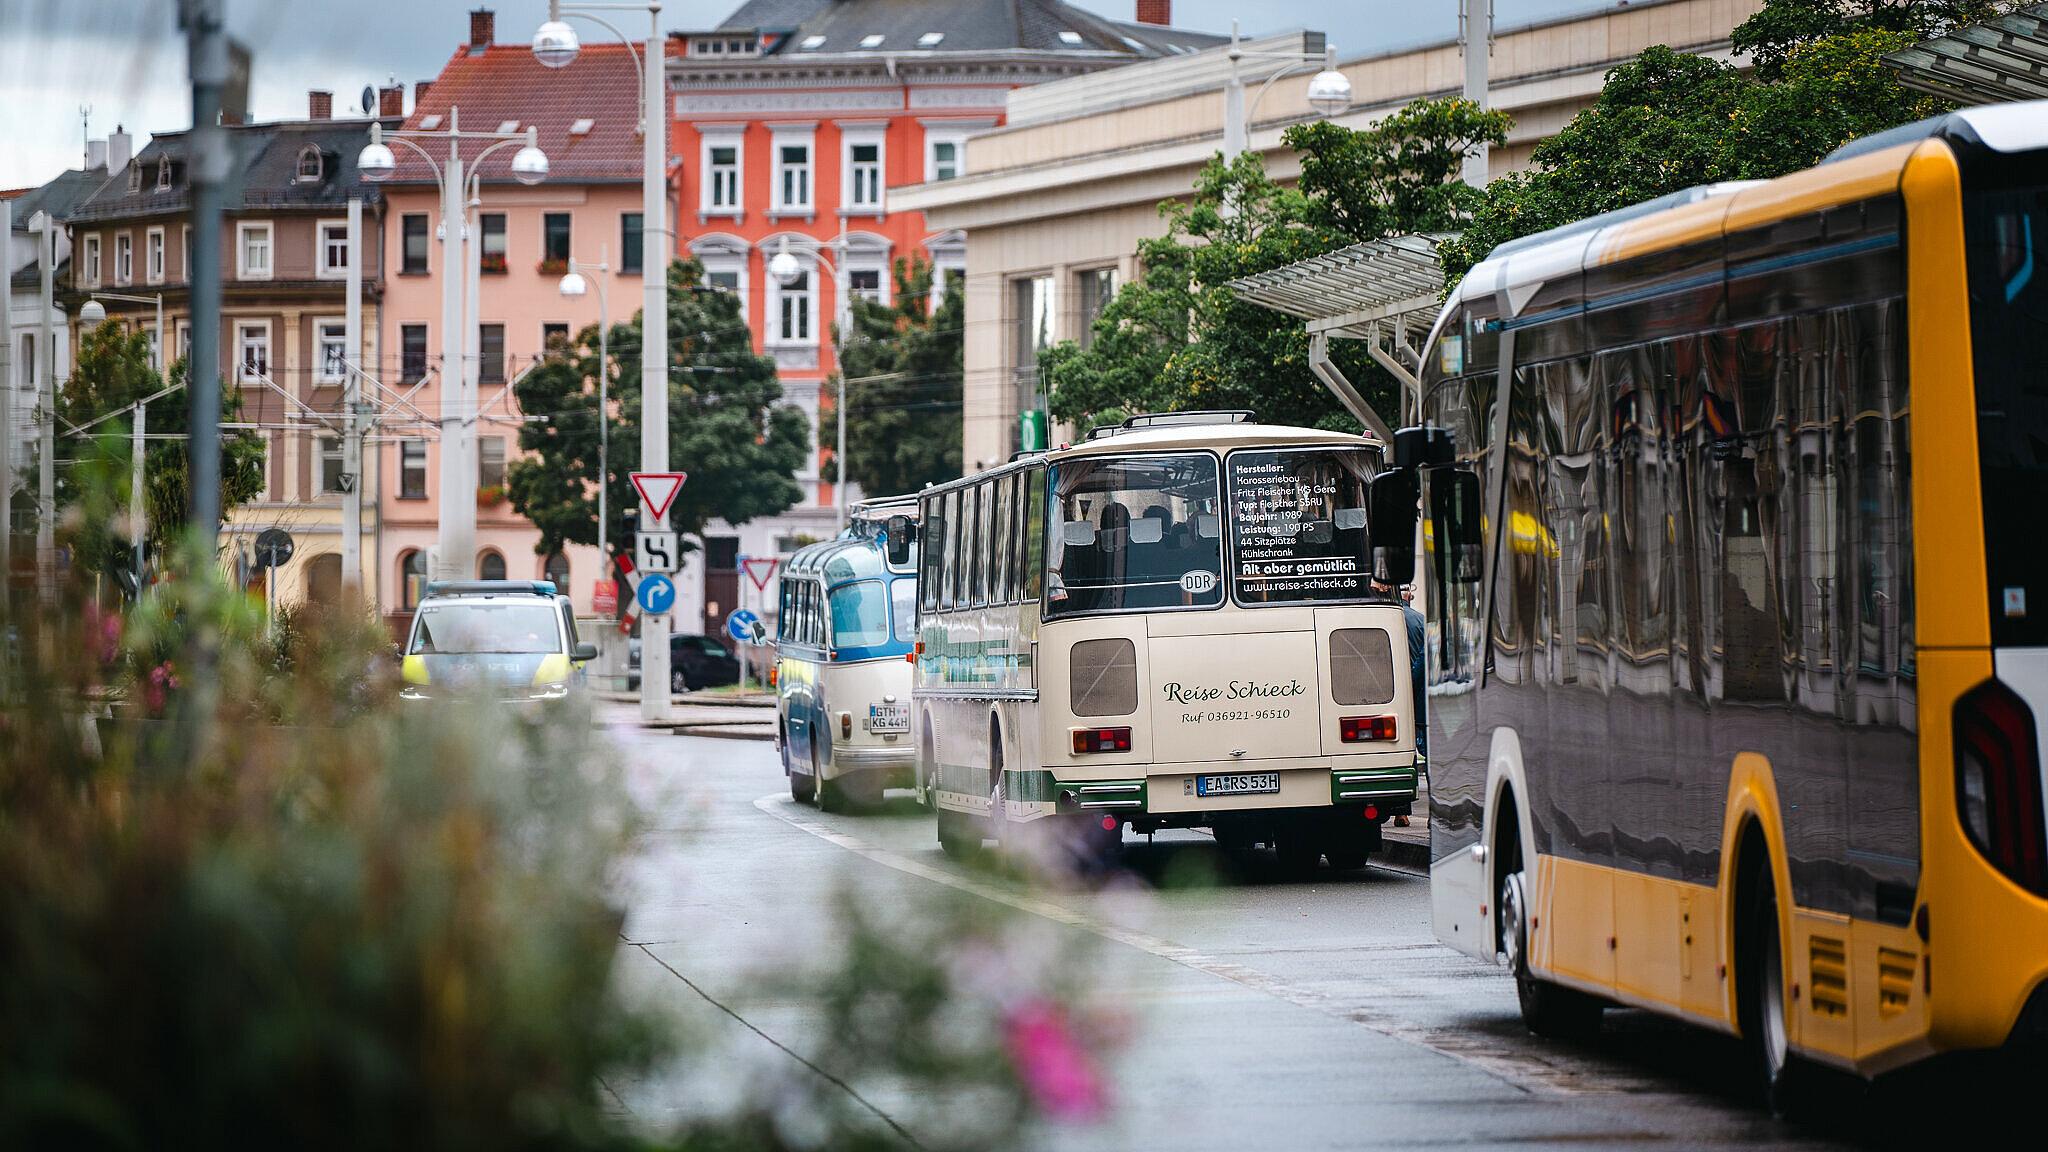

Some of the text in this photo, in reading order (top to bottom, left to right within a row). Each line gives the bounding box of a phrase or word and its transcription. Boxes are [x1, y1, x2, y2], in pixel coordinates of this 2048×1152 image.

[1236, 464, 1284, 474] Hersteller:
[1237, 475, 1300, 485] Karosseriebau
[1238, 489, 1256, 497] Fritz
[1257, 487, 1295, 496] Fleischer
[1313, 485, 1336, 494] Gera
[1239, 501, 1258, 511] Typ:
[1260, 499, 1297, 509] Fleischer
[1240, 511, 1303, 523] Baujahr: 1989
[1240, 523, 1314, 535] Leistung: 190 PS
[1241, 537, 1297, 547] 44 Sitzplätze
[1241, 548, 1294, 559] Kühlschrank
[1242, 560, 1356, 576] Alt aber gemütlich
[1186, 575, 1211, 589] DDR
[1243, 578, 1358, 592] www.reise-schieck.de
[1163, 679, 1306, 705] Reise Schieck
[876, 707, 896, 716] GTH
[1182, 708, 1291, 724] Ruf 036921-96510
[872, 717, 886, 728] KG
[1206, 777, 1223, 791] EA
[1231, 776, 1248, 790] RS
